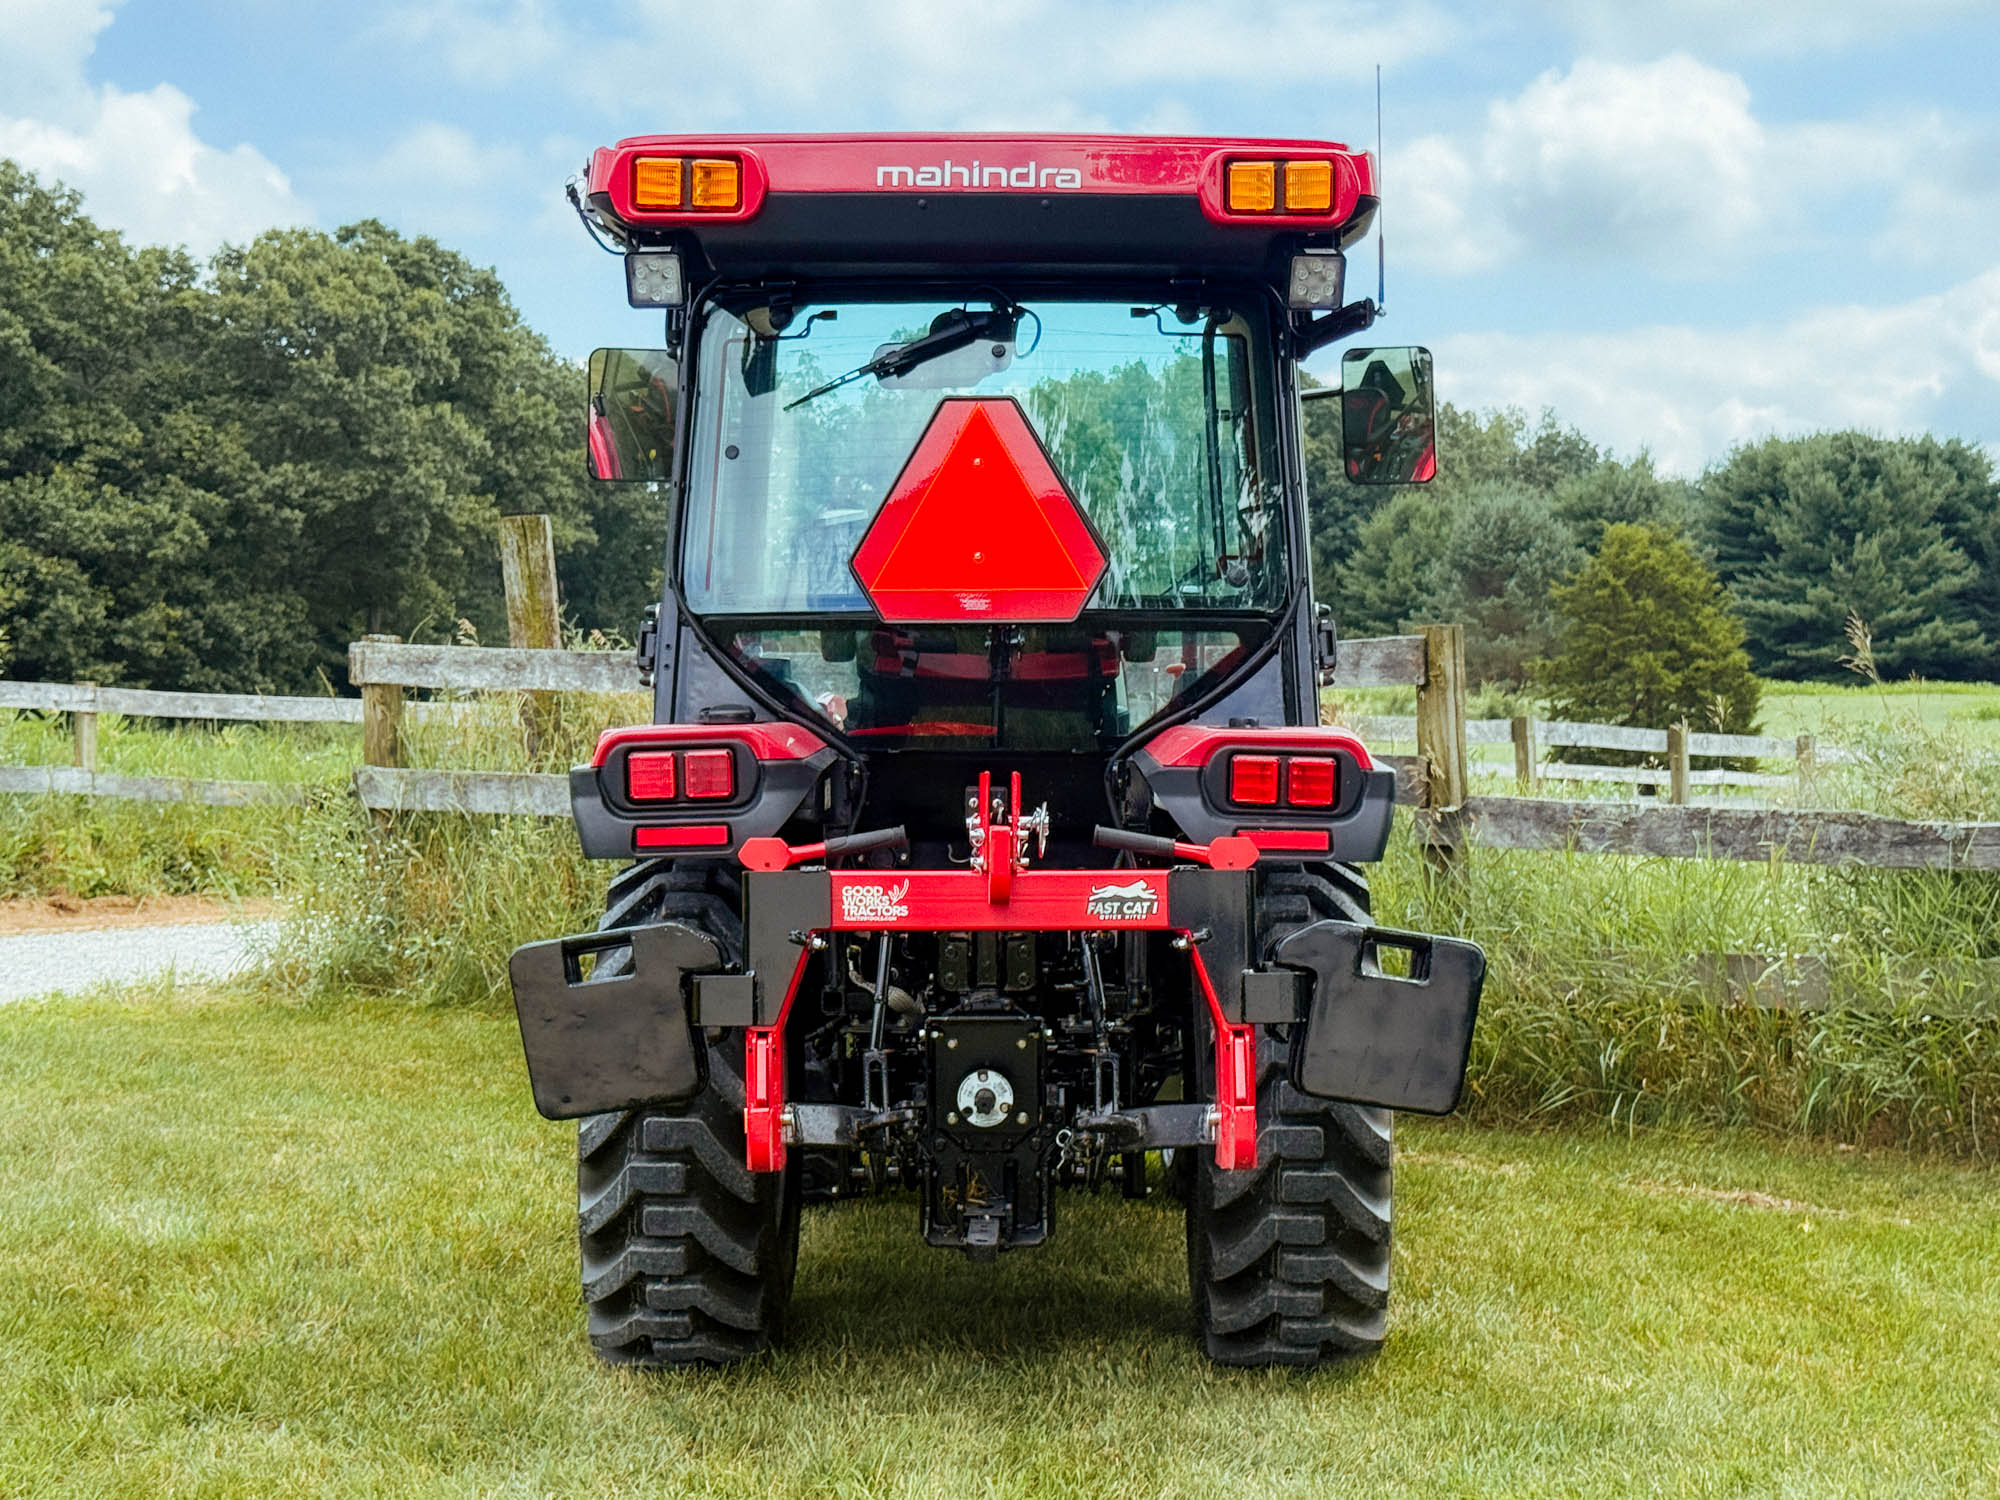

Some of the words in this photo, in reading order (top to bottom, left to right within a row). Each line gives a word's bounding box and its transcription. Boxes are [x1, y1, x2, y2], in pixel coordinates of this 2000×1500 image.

[876, 160, 1082, 189] mahindra
[842, 886, 883, 896] GOOD
[842, 896, 890, 906] WORKS
[842, 905, 909, 917] TRACTORS
[1087, 902, 1120, 915] FAST
[1123, 902, 1150, 914] CAT
